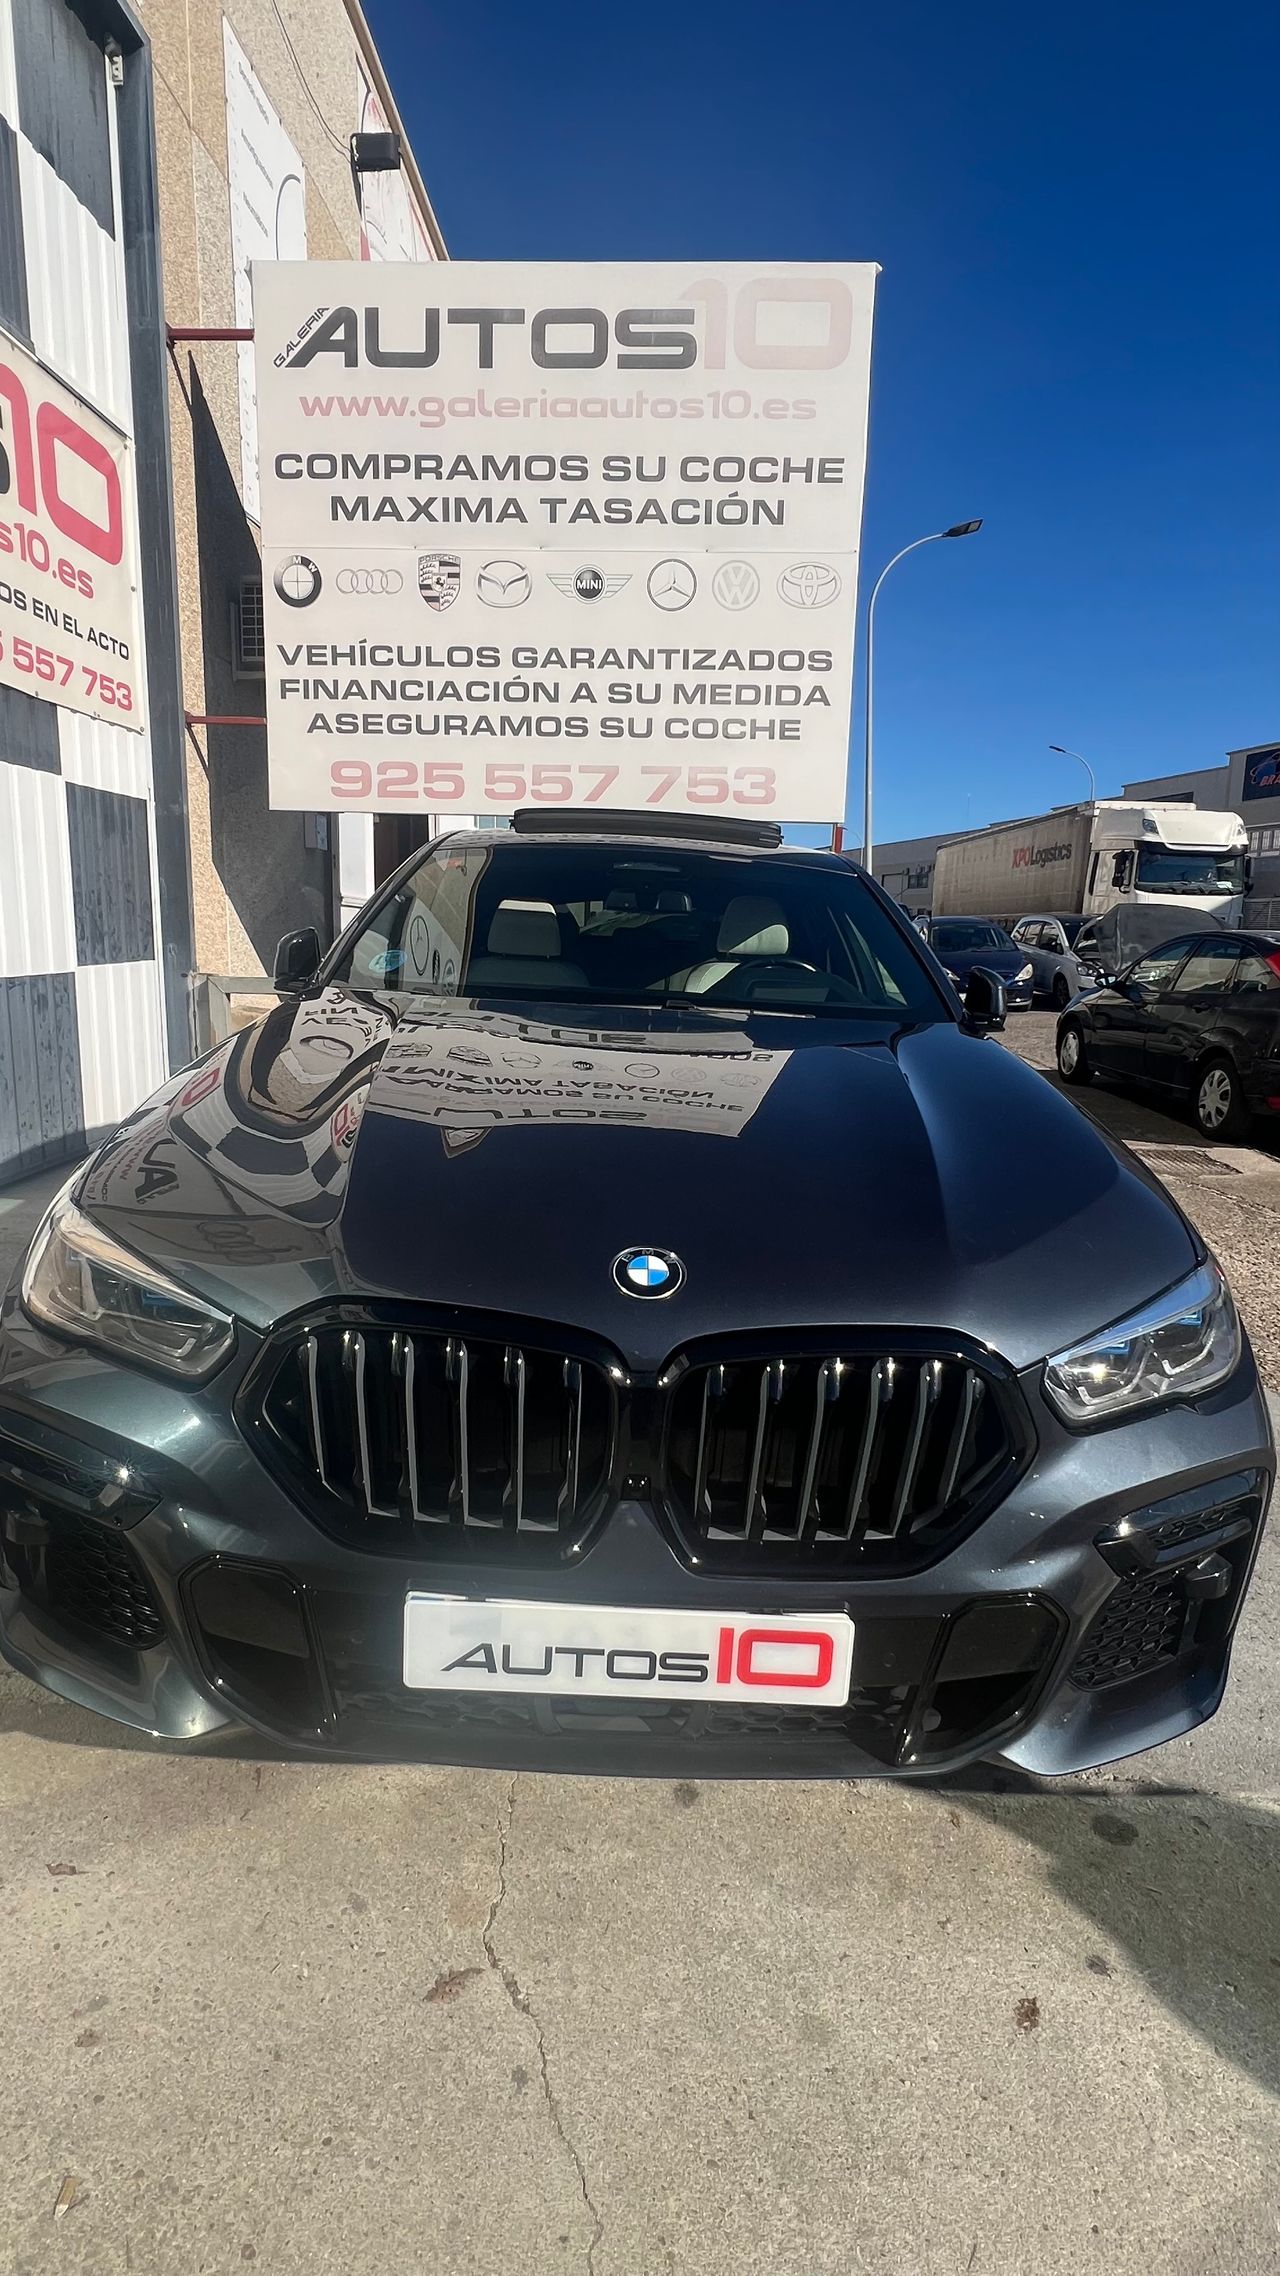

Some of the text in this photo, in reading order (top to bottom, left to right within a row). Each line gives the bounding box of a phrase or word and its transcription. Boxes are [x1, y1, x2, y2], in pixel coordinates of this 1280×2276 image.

[273, 307, 330, 368] GALERIA
[299, 388, 816, 428] www.galeriaautos10.es
[275, 453, 845, 484] COMPRAMOS SU COCHE
[331, 490, 785, 526] MAXIMA TASACIÓN
[576, 579, 602, 590] MINI
[32, 597, 58, 627] EN
[62, 613, 83, 639] EL
[87, 627, 129, 660] ACTO
[12, 636, 74, 687] 557
[81, 665, 133, 711] 753
[277, 639, 833, 672] VEHÍCULOS GARANTIZADOS
[280, 675, 831, 706] FINANCIACIÓN A SU MEDIDA
[307, 713, 801, 741] ASEGURAMOS SU COCHE
[330, 760, 777, 804] 925 557 753
